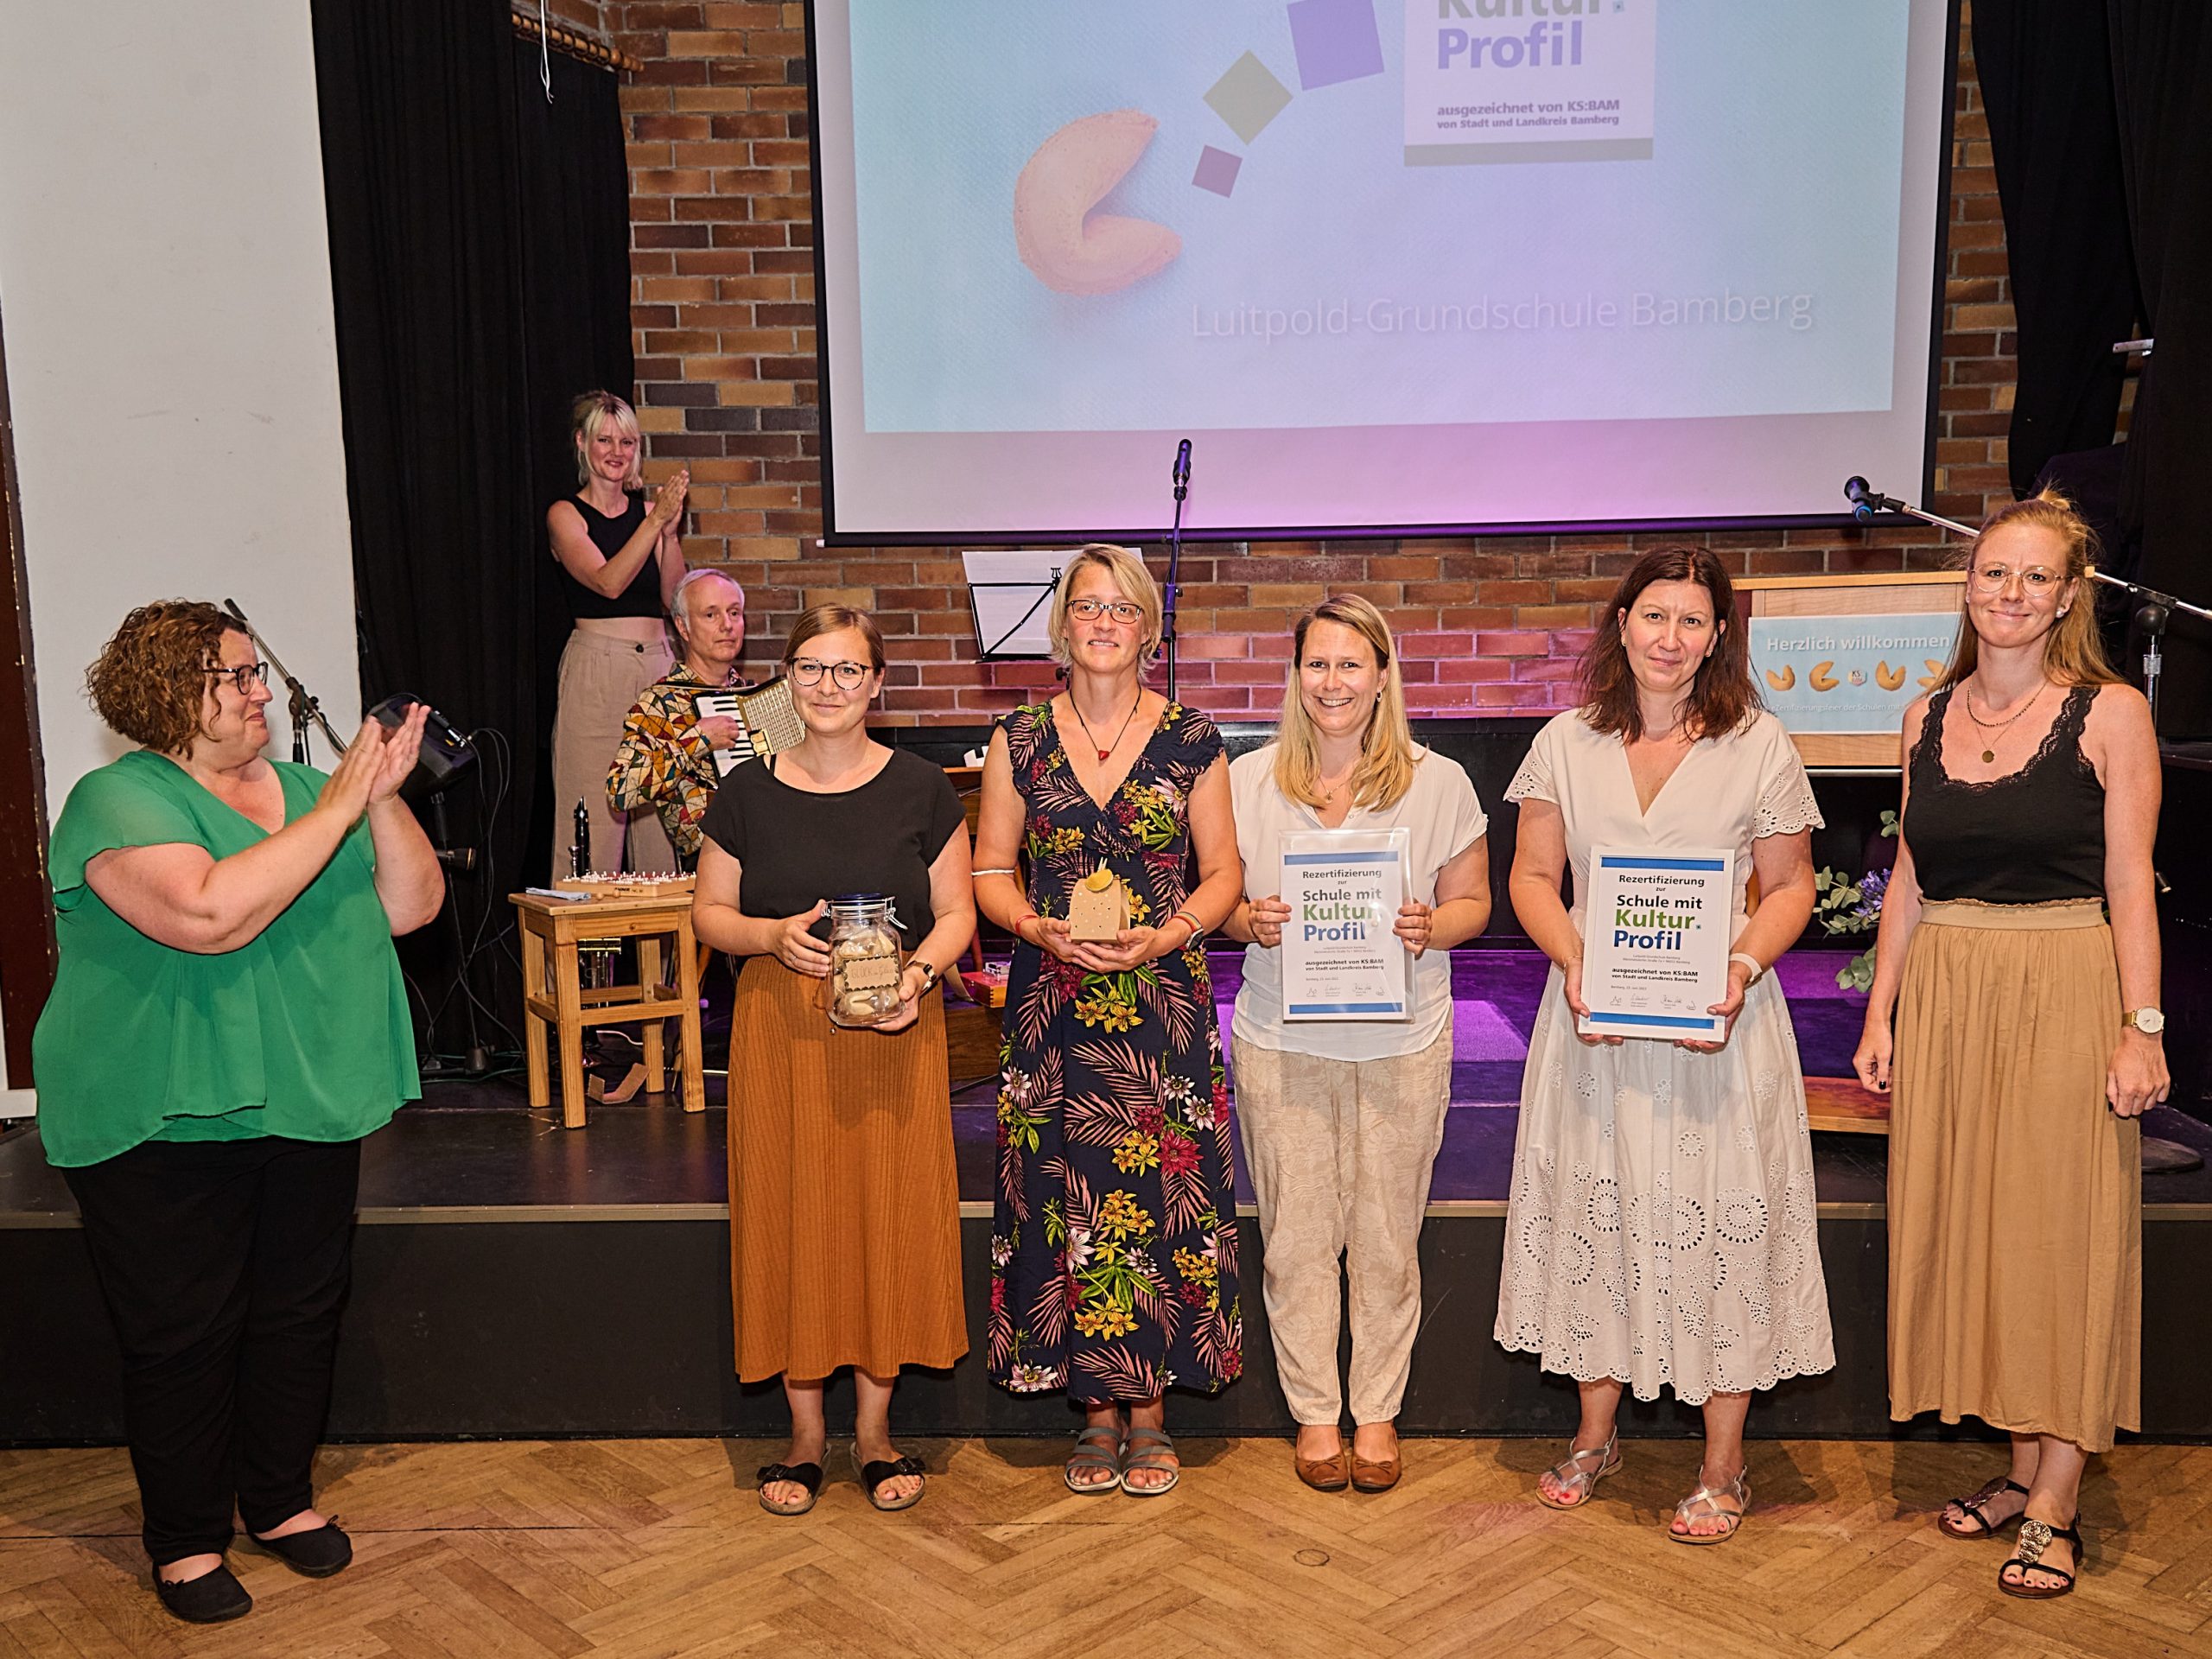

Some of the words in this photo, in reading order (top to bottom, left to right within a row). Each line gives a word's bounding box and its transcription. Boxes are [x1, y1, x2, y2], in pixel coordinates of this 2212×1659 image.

[1438, 21, 1582, 69] Profil
[1437, 102, 1534, 118] ausgezeichnet
[1538, 103, 1562, 113] von
[1567, 99, 1620, 111] KS:BAM
[1437, 120, 1457, 129] von
[1460, 118, 1489, 128] Stadt
[1492, 118, 1513, 127] und
[1516, 117, 1567, 127] Landkreis
[1570, 115, 1619, 126] Bamberg
[1192, 292, 1618, 344] Luitpold-Grundschule
[1631, 288, 1815, 329] Bamberg
[1767, 636, 1836, 652] Herzlich
[1840, 634, 1950, 650] willkommen
[1302, 869, 1382, 880] Rezertifizierung
[1618, 874, 1705, 887] Rezertifizierung
[1303, 888, 1351, 901] Schule
[1357, 887, 1382, 899] mit
[1617, 894, 1669, 908] Schule
[1675, 896, 1702, 909] mit
[1304, 922, 1365, 942] Profil
[1613, 930, 1681, 950] Profil
